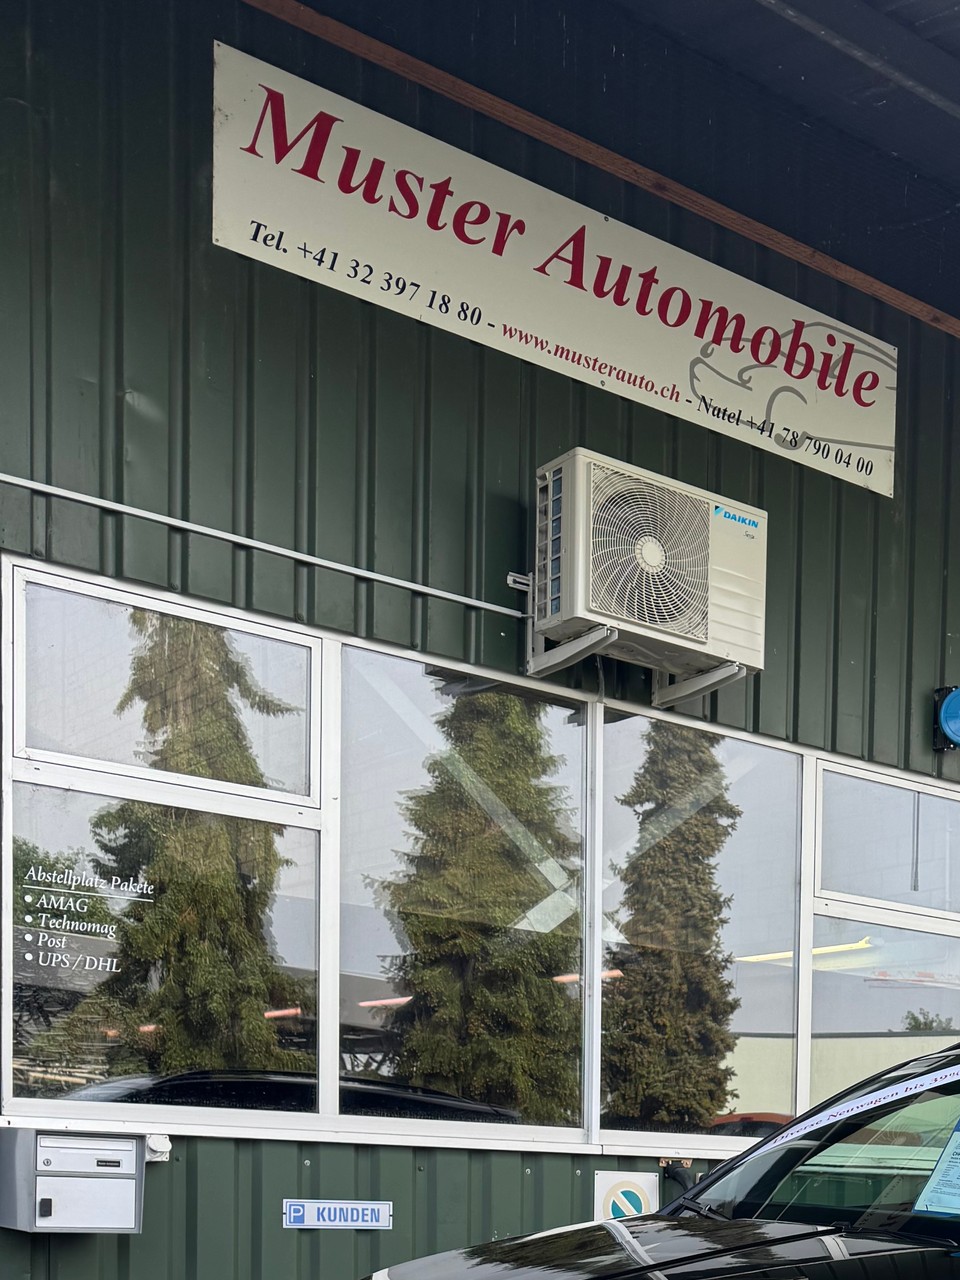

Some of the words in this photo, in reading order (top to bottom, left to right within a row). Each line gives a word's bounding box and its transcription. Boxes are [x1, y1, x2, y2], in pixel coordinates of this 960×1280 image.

[239, 83, 526, 256] Muster
[534, 224, 881, 408] Automobile
[250, 220, 288, 253] Tel.
[297, 242, 339, 272] +41
[346, 259, 374, 284] 32
[380, 272, 421, 301] 397
[426, 290, 451, 314] 18
[457, 302, 482, 325] 80
[502, 323, 680, 402] www.musterauto.ch
[697, 395, 742, 426] Natel
[746, 415, 775, 439] +41
[781, 427, 799, 448] 78
[804, 435, 830, 459] 790
[834, 448, 852, 468] 04
[856, 457, 874, 476] 00
[723, 510, 759, 528] DAIKIN
[24, 865, 107, 890] Abstellplatz
[111, 875, 155, 894] Pakete
[36, 894, 89, 912] AMAG
[37, 912, 117, 939] Technomag
[37, 932, 67, 949] Post
[38, 951, 70, 968] UPS
[85, 956, 122, 972] DHL
[827, 1091, 900, 1121] Neuwagen
[316, 1206, 380, 1223] KUNDEN
